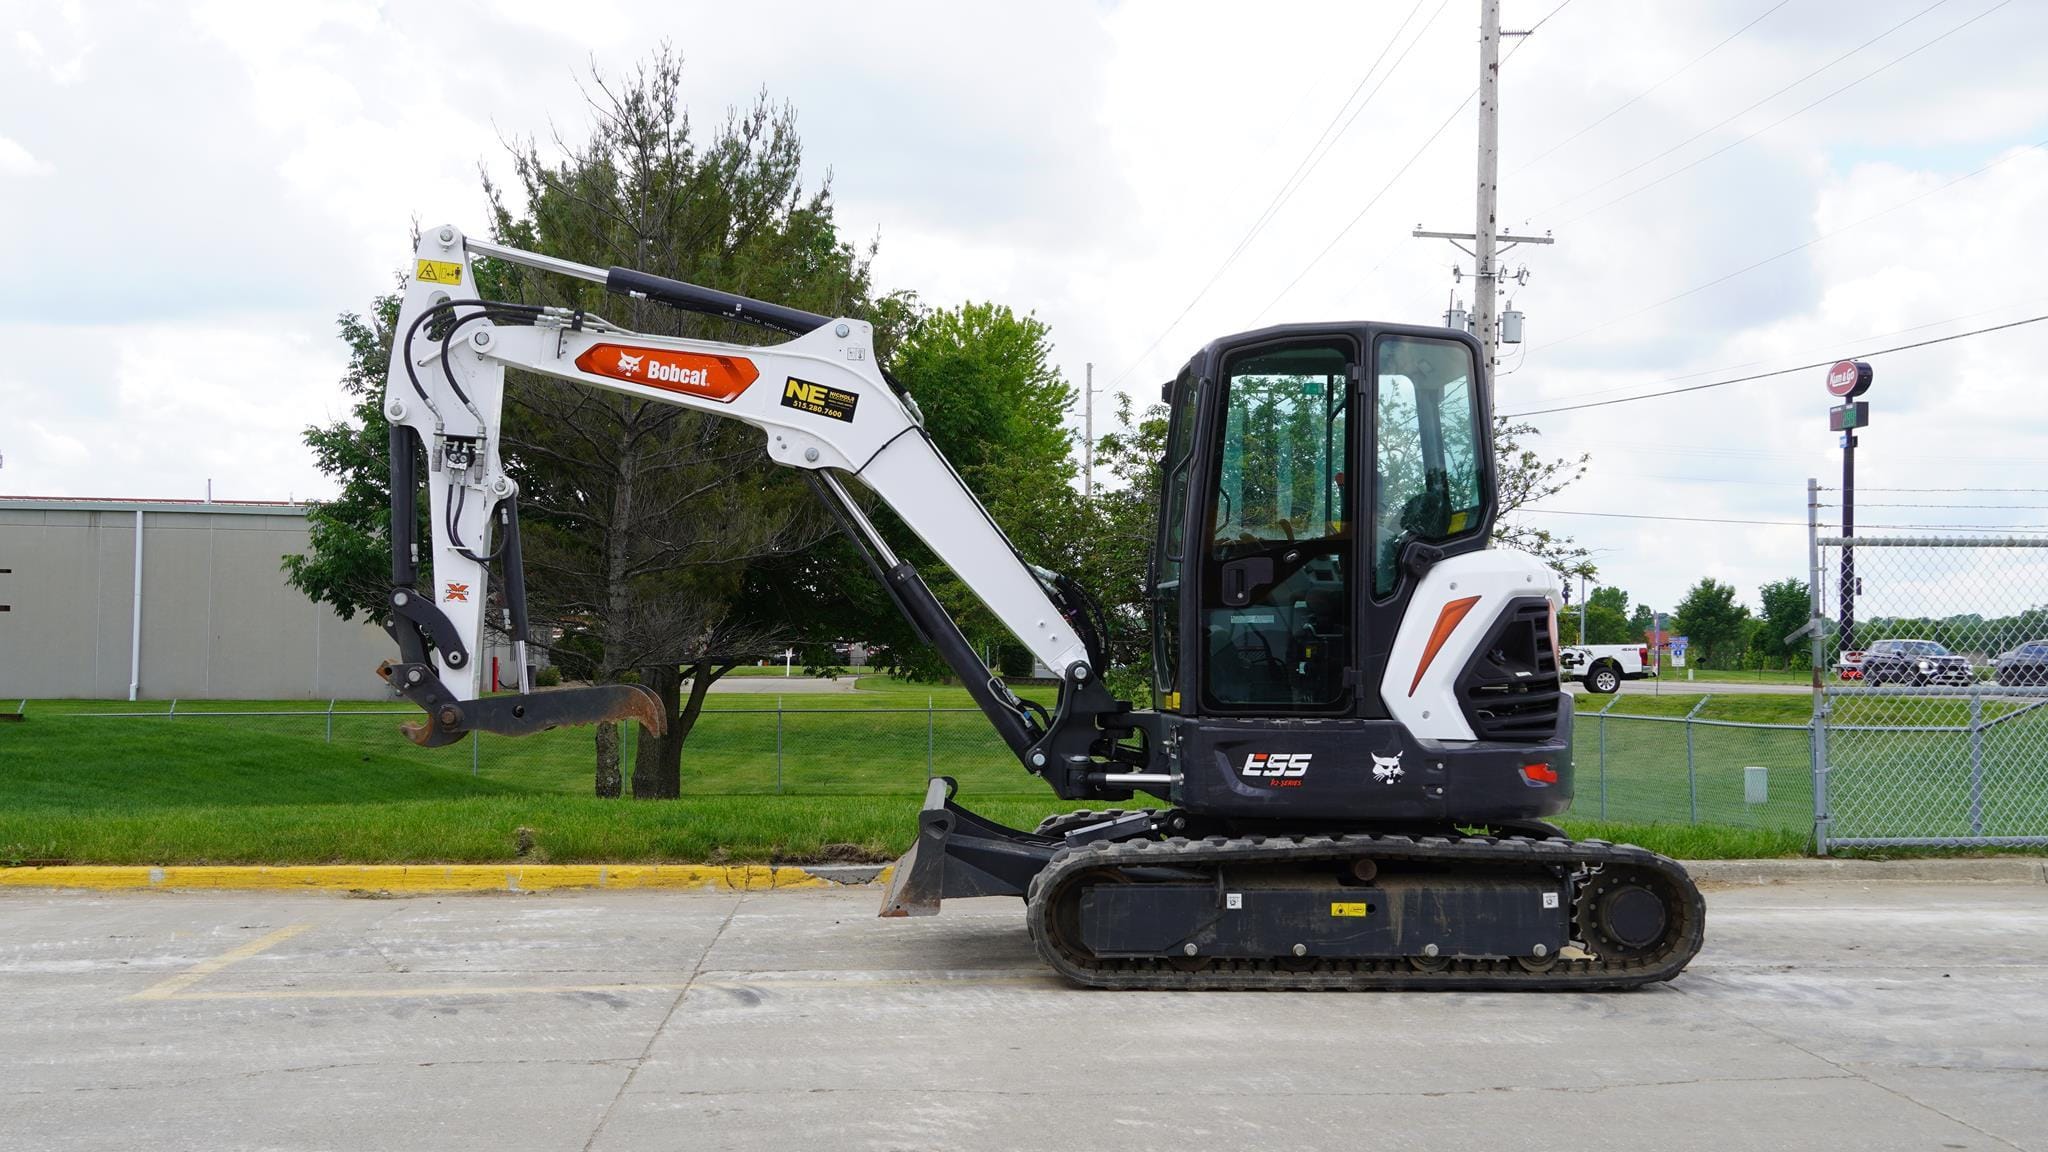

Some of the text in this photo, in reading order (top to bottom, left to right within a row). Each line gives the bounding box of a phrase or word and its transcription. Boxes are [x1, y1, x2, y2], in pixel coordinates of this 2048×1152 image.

[648, 360, 708, 387] Bobcat
[786, 380, 828, 406] NE
[793, 400, 842, 418] 515.280.7600
